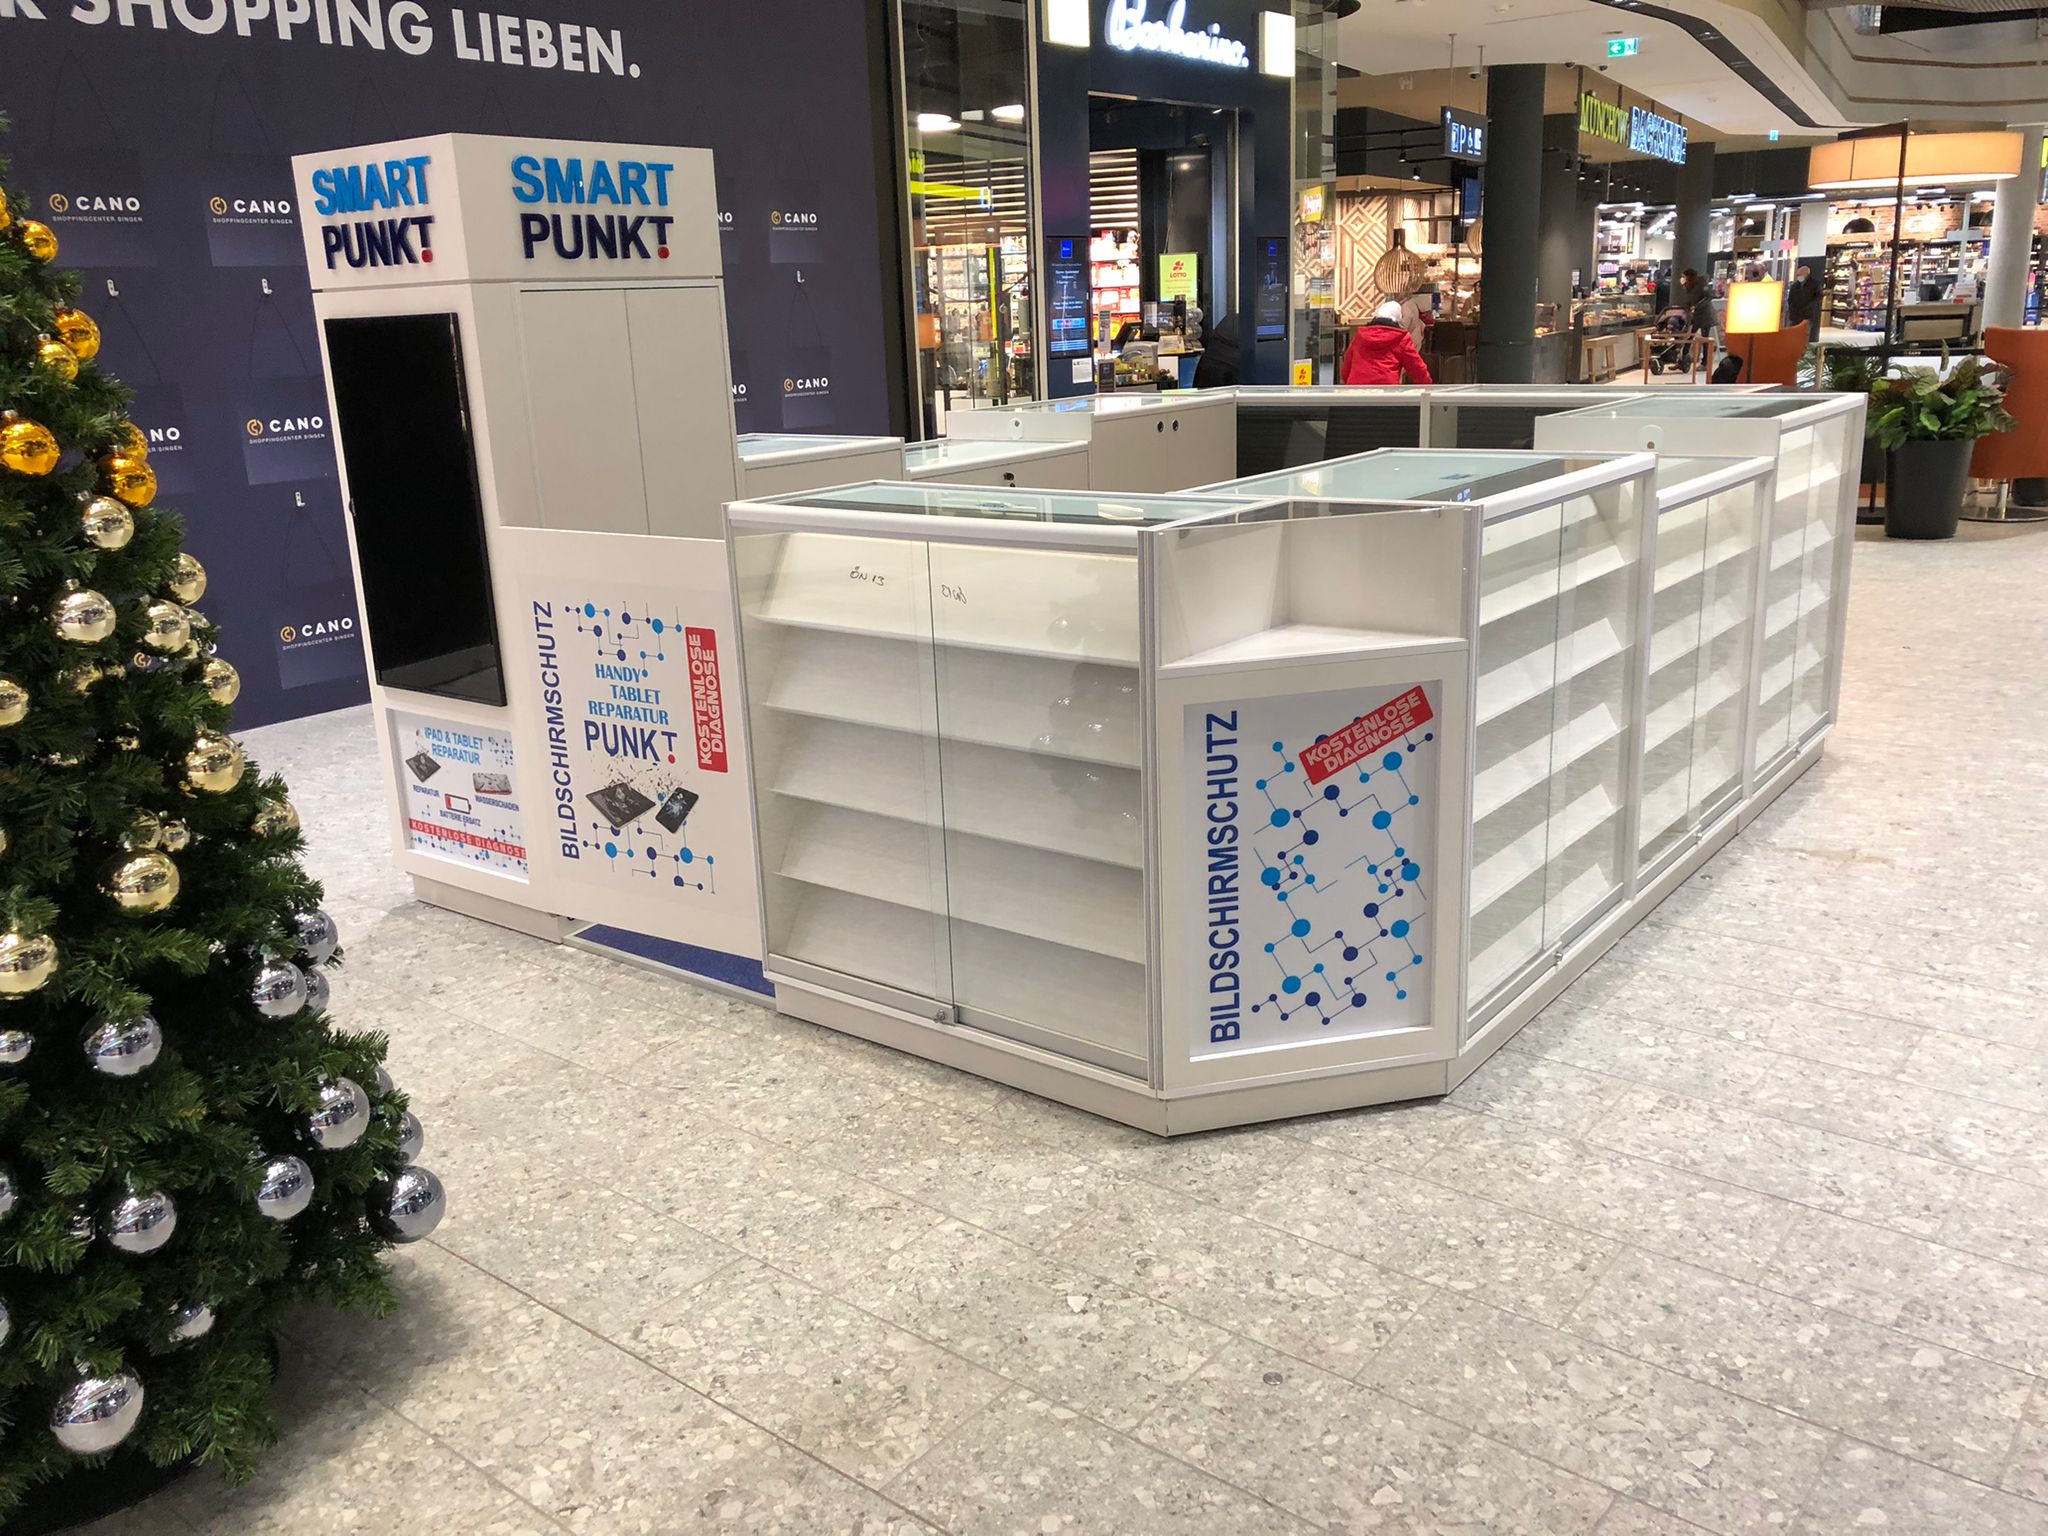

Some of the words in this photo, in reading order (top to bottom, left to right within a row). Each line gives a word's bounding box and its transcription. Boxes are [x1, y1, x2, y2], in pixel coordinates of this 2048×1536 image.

[452, 8, 641, 78] LIEBEN.
[312, 155, 431, 216] SMART
[511, 154, 674, 206] SMART
[76, 196, 141, 211] CANO
[233, 199, 291, 214] CANO
[784, 212, 817, 223] CANO
[797, 377, 829, 389] CANO
[269, 416, 323, 433] CANO
[301, 617, 353, 637] CANO
[595, 663, 641, 683] HANDY
[610, 684, 661, 705] TABLET
[688, 633, 712, 764] KOSTENLOSE
[704, 649, 724, 753] DIAGNOSE
[588, 700, 669, 725] REPARATUR
[533, 601, 580, 860] BILDSCHIRMSCHUTZ
[1305, 691, 1422, 766] KOSTENLOSE
[452, 732, 483, 750] TABLET
[1323, 711, 1416, 773] DIAGNOSE
[431, 743, 481, 765] REPARATUR
[412, 784, 440, 797] REPARATUR
[475, 795, 519, 812] WASSERSCHADEN
[440, 810, 462, 822] BATTERIE
[463, 815, 481, 827] ERSATZ
[411, 820, 472, 844] KOSTENLOSE
[475, 837, 527, 858] DIAGNOSE
[1206, 710, 1241, 1043] BILDSCHIRMSCHUTZ
